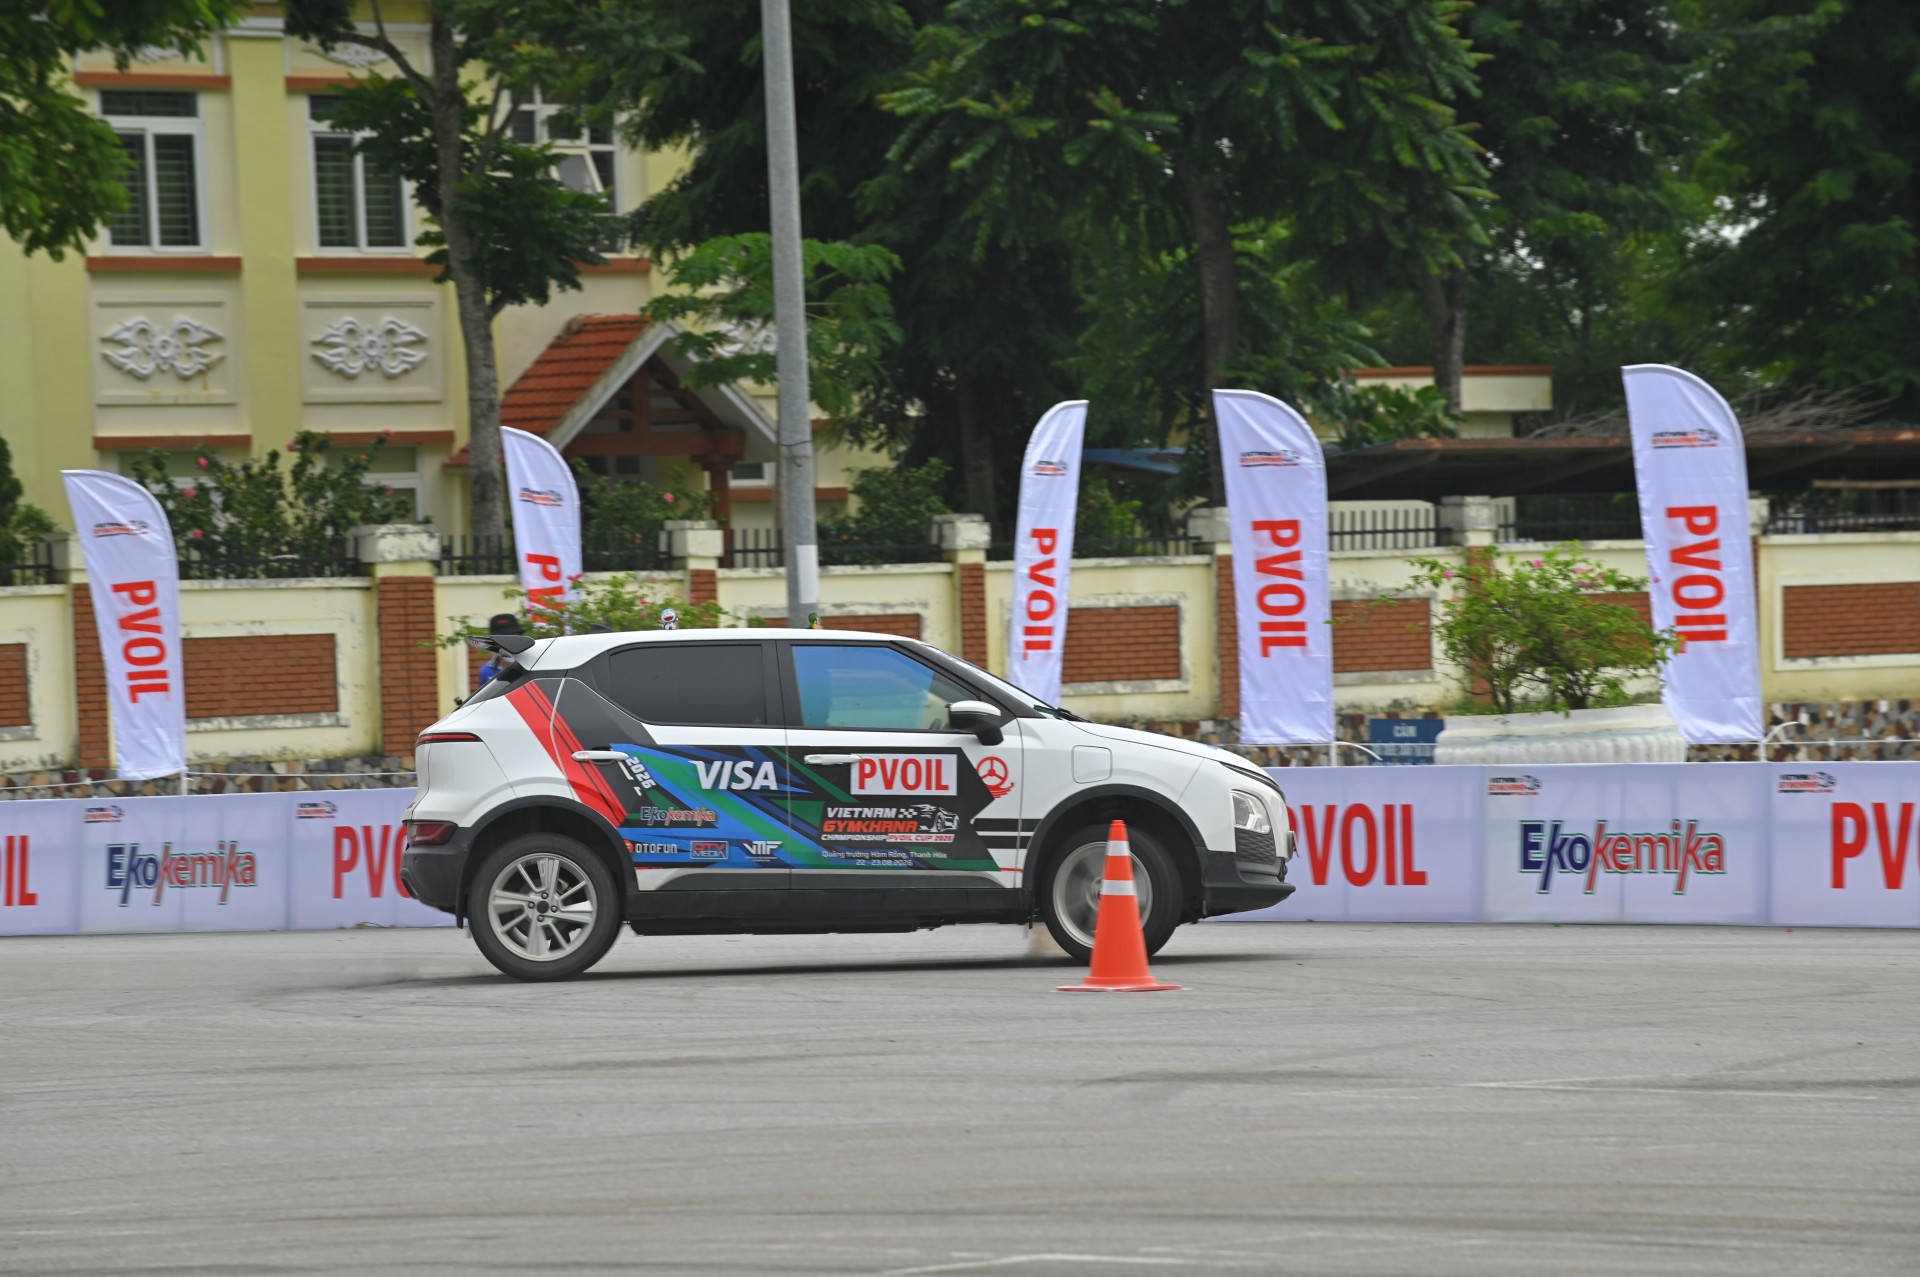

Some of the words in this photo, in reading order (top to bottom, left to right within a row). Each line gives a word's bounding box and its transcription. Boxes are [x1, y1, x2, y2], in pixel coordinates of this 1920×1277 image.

[1022, 528, 1058, 661] PVOIL
[1252, 519, 1308, 658] PVOIL
[1665, 505, 1728, 654] PVOIL
[111, 580, 171, 704] PVOIL
[625, 756, 657, 789] 2026
[688, 760, 779, 790] VISA
[859, 758, 949, 790] PVOIL
[640, 806, 717, 826] Ekokemika
[823, 820, 918, 832] GYMKHANA
[827, 807, 897, 818] VIETNAM
[0, 834, 38, 906] IL
[105, 841, 258, 906] Ekokemika
[635, 843, 678, 854] OTOFUN
[1519, 819, 1727, 895] Ekokemika
[1831, 802, 1920, 889] PV
